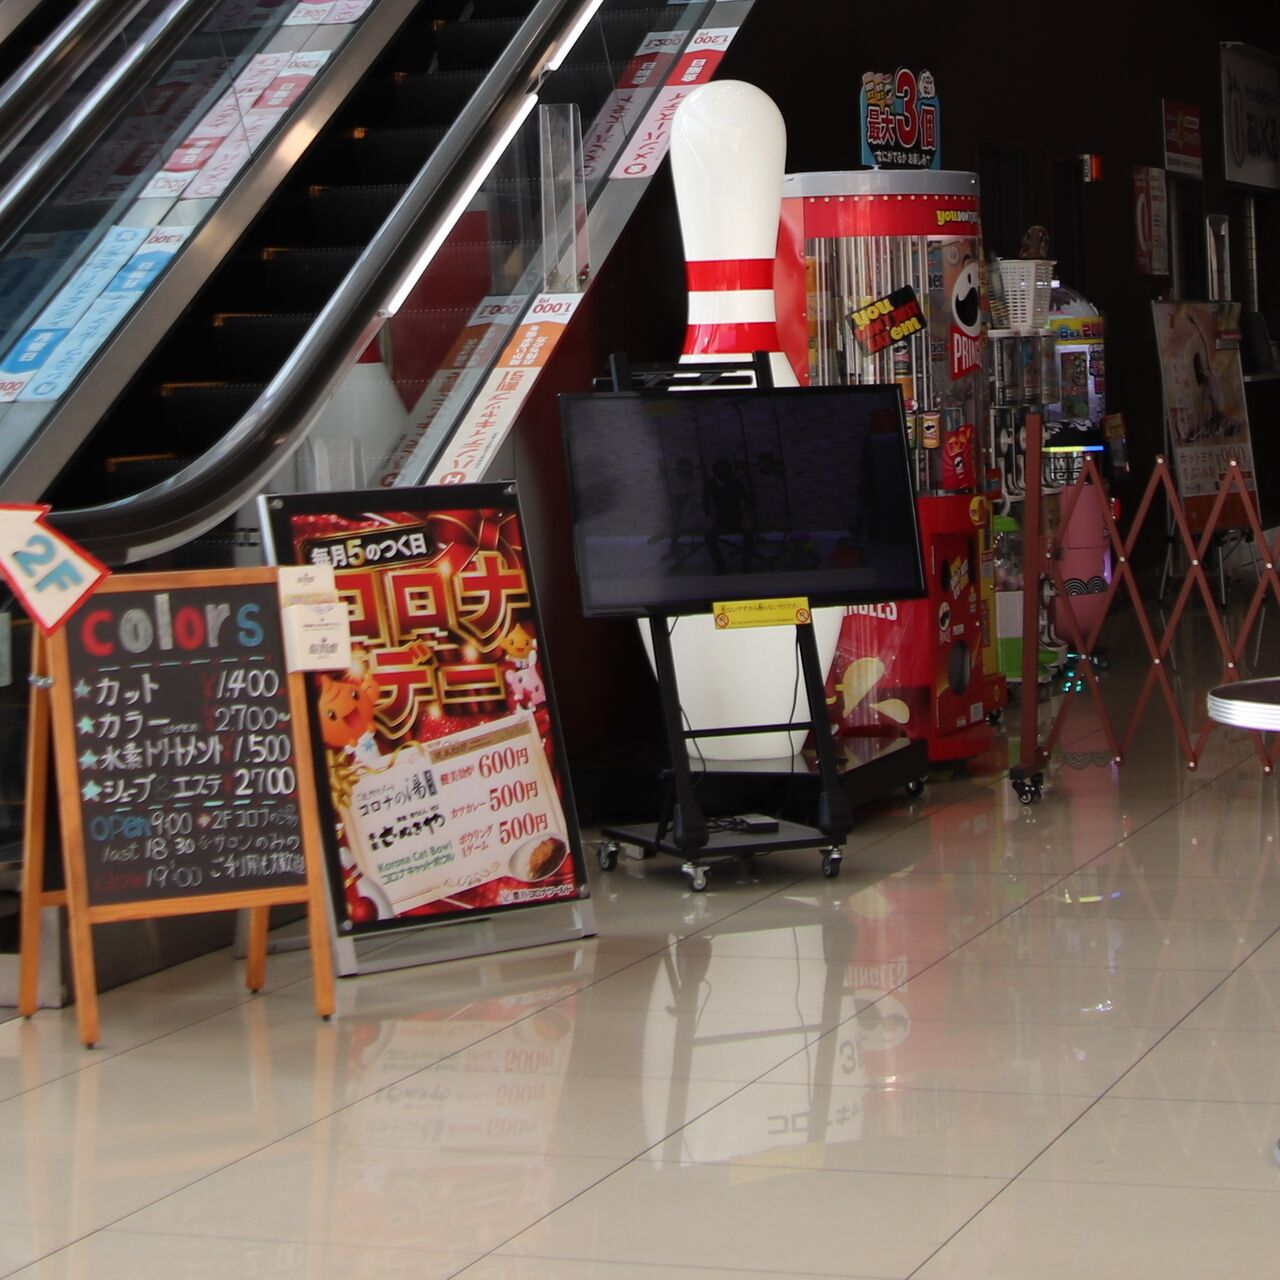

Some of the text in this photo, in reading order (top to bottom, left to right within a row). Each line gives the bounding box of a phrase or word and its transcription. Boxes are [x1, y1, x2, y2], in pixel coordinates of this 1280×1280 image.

[12, 534, 85, 593] 2F
[311, 532, 428, 568] 毎月5のつく日
[334, 550, 531, 652] コロナ
[96, 673, 160, 706] カット
[372, 640, 507, 736] デー
[96, 711, 171, 740] カラー
[478, 746, 529, 779] 600円
[172, 775, 223, 798] エステ
[357, 773, 426, 817] コロナの湯
[449, 800, 488, 819] カツカレー
[488, 780, 540, 812] 500円
[458, 812, 549, 845] ボウリング 500円
[103, 841, 140, 863] last
[376, 840, 453, 873] Korona Cat Bowl
